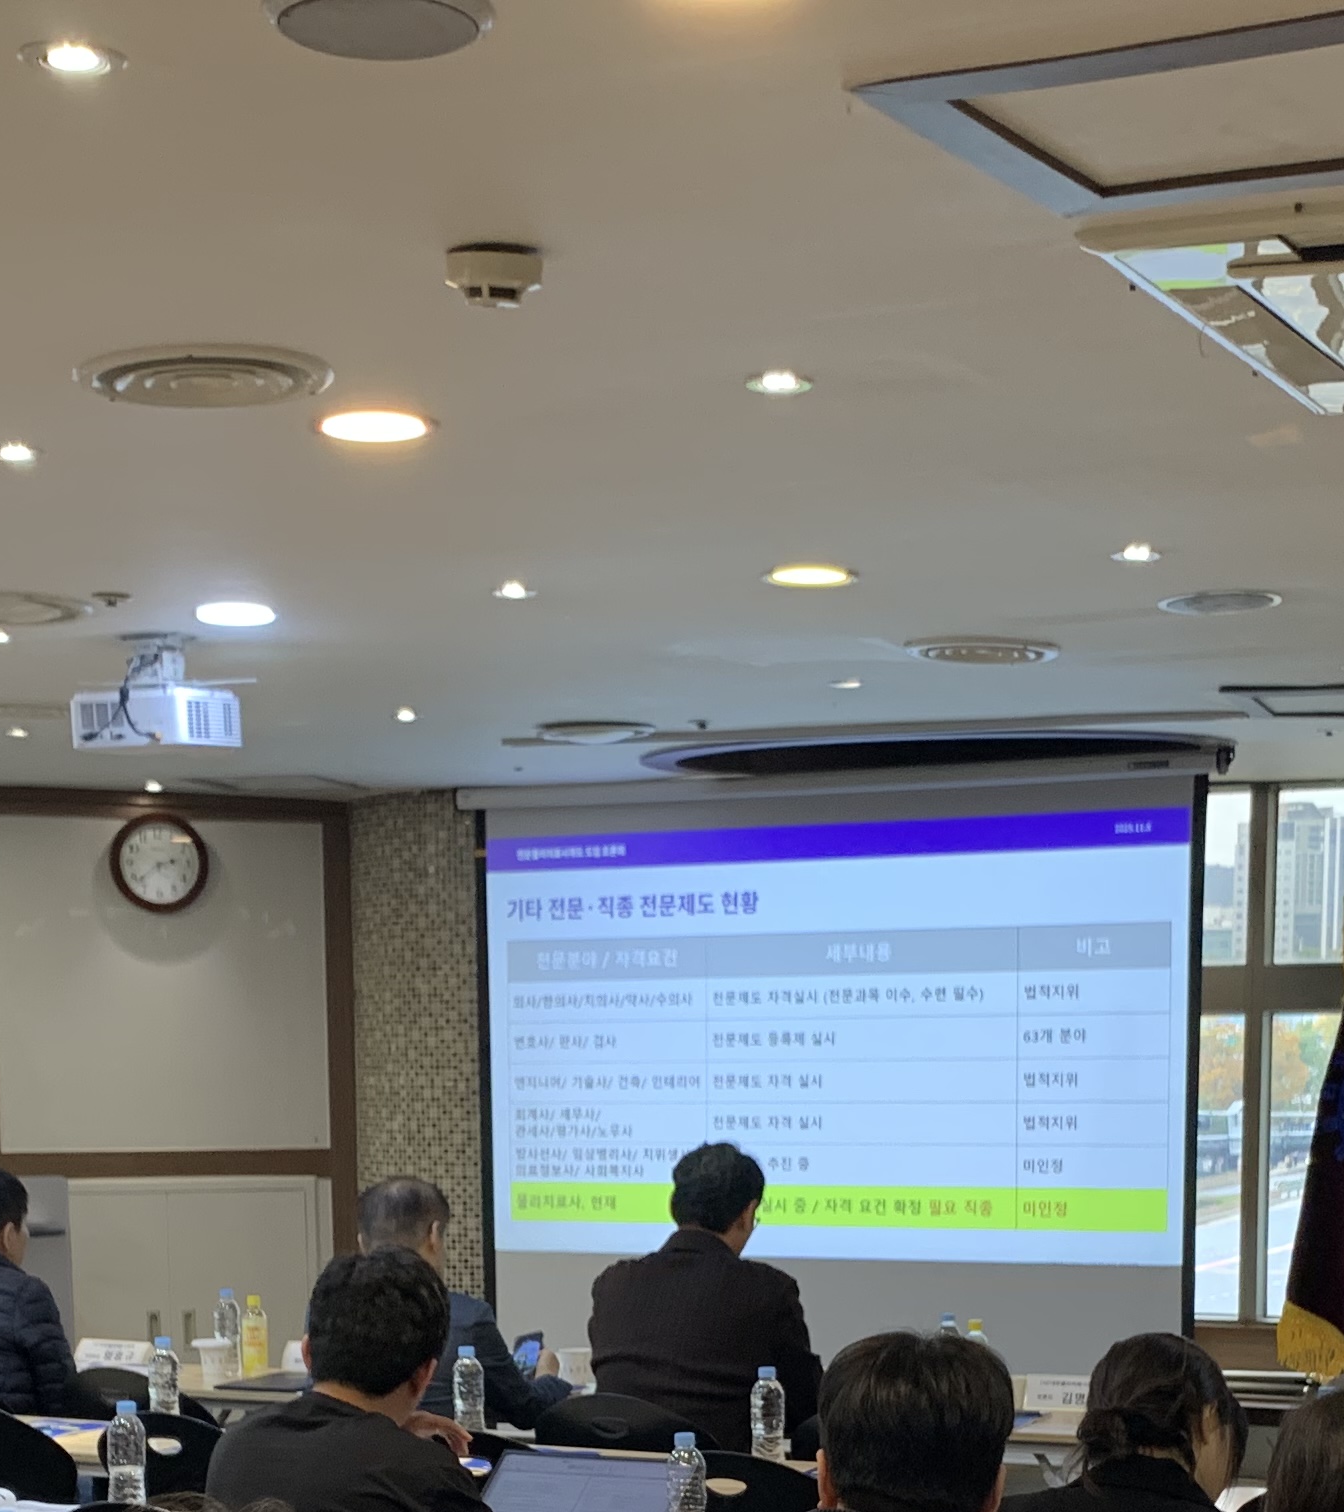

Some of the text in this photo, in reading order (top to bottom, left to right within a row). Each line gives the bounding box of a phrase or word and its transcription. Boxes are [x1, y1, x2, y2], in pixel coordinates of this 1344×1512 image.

[507, 898, 542, 922] 기타
[640, 892, 716, 918] 전문제도
[721, 889, 760, 916] 현황
[826, 941, 892, 963] 세부내용
[1076, 936, 1111, 958] 비고
[537, 950, 597, 971] 전문분야
[614, 948, 678, 969] 자격요건
[713, 990, 762, 1006] 전문제도
[767, 988, 818, 1005] 자격실시
[823, 986, 879, 1006] (전문과목
[885, 985, 915, 1004] 이수,
[953, 985, 984, 1003] 필수)
[1024, 983, 1080, 1001] 법적지위
[712, 1031, 762, 1048] 전문제도
[811, 1030, 836, 1046] 실시
[1023, 1027, 1087, 1044] 63개 분야
[713, 1073, 823, 1089] 전문제도 자격 실시
[1023, 1071, 1078, 1088] 법적지위
[712, 1115, 823, 1131] 전문제도 자격 실시
[1023, 1115, 1078, 1131] 법적지위
[767, 1155, 792, 1172] 추진
[1023, 1158, 1063, 1175] 미인정
[794, 1198, 807, 1214] 중
[824, 1198, 851, 1214] 자격
[859, 1198, 887, 1215] 요건
[894, 1199, 922, 1216] 확정
[928, 1199, 957, 1216] 필요
[964, 1199, 993, 1218] 직종
[1023, 1200, 1068, 1218] 미인정
